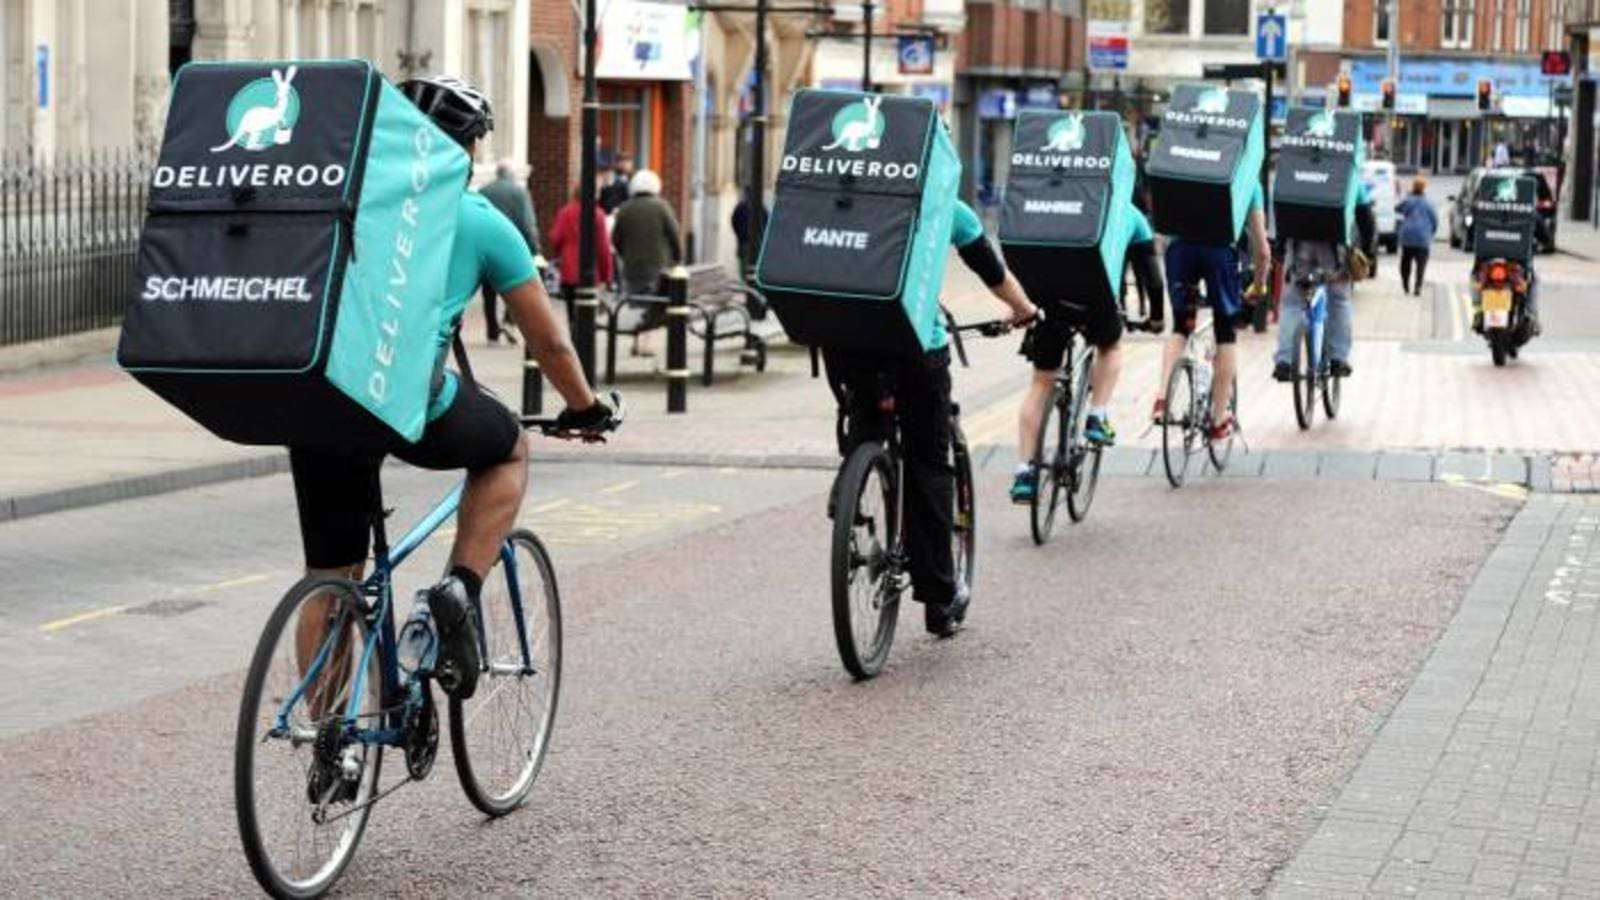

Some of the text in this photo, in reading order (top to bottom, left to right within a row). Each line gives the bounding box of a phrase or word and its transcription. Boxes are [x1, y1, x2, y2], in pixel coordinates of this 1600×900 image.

[782, 156, 918, 179] DELIVEROO
[1012, 153, 1110, 169] DELIVEROO
[154, 164, 345, 187] DELIVEROO
[803, 227, 869, 249] KANTE
[369, 127, 434, 406] DELIVEROO
[142, 275, 312, 301] SCHMEICHEL
